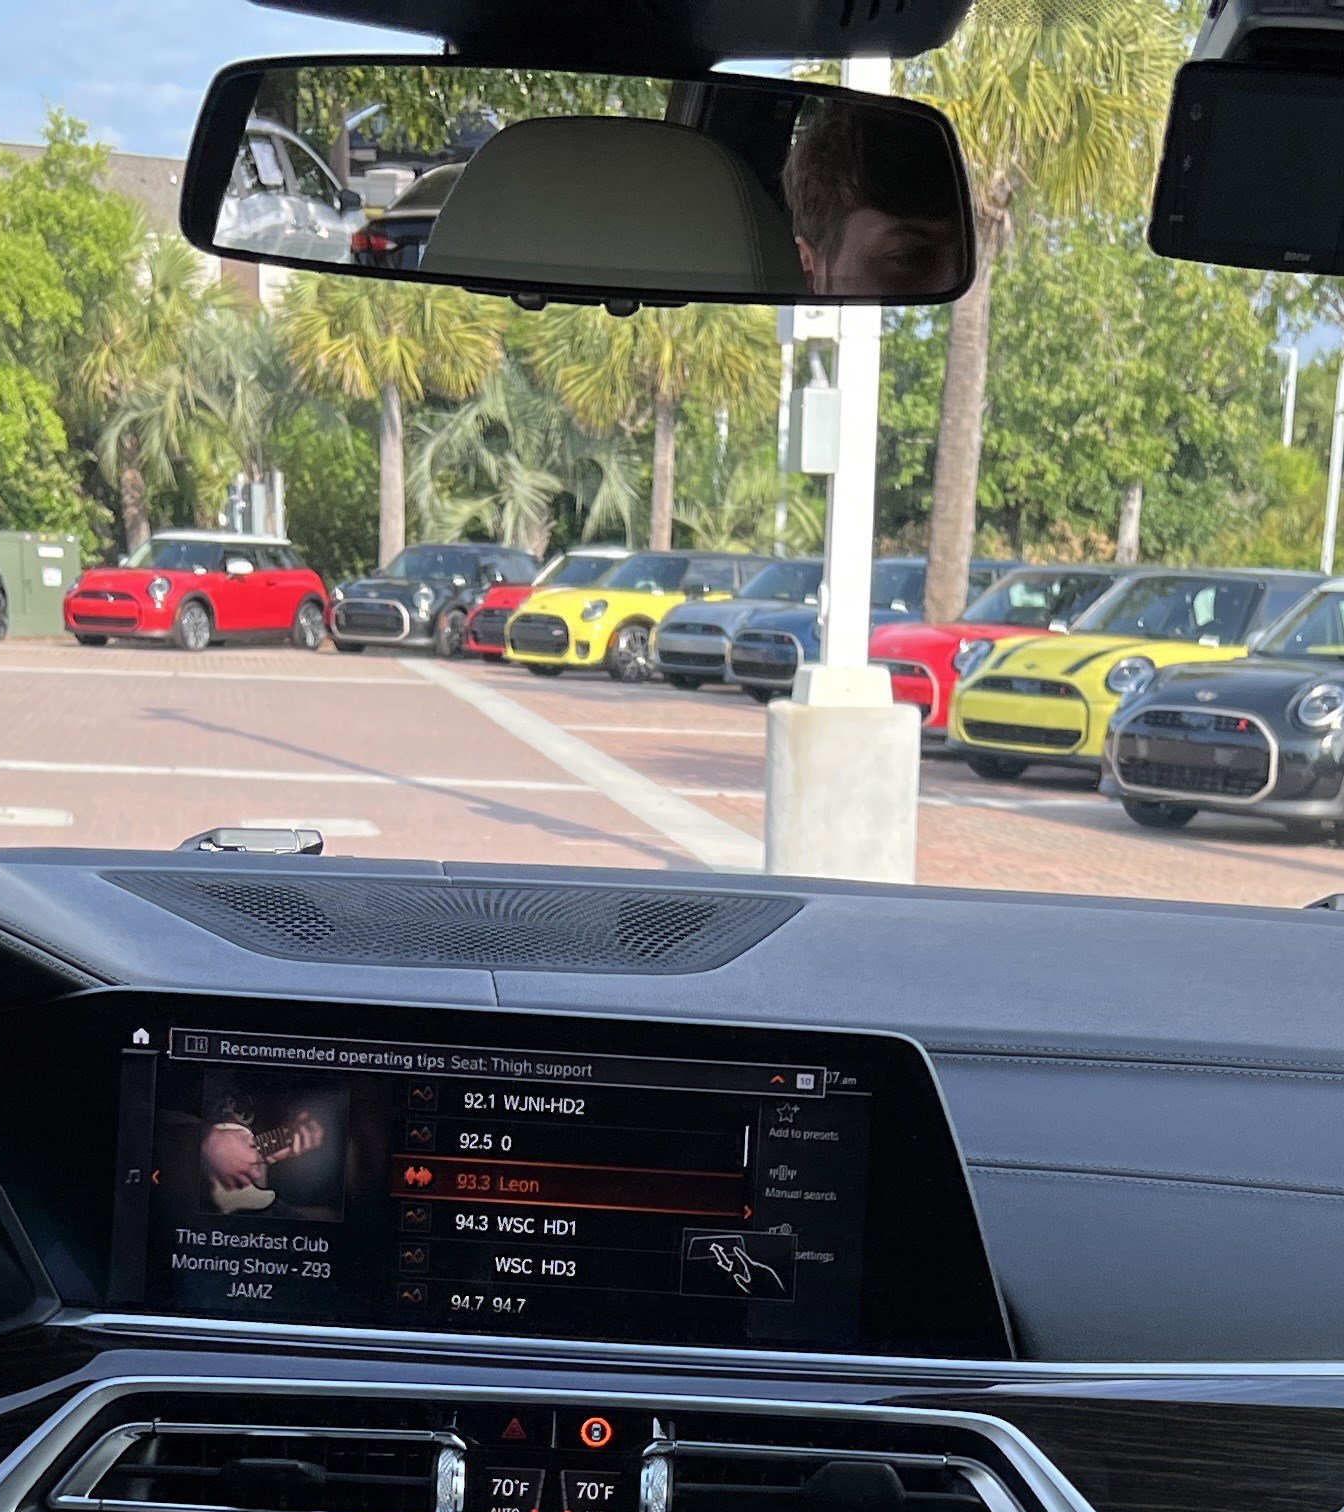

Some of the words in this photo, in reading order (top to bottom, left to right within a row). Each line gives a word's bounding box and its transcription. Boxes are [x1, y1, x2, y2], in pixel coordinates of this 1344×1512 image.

[219, 1039, 336, 1063] Recommended
[338, 1049, 413, 1069] operating
[416, 1053, 445, 1069] tips
[450, 1055, 488, 1072] Seat:
[491, 1057, 533, 1075] Thigh
[535, 1063, 594, 1079] support
[463, 1092, 496, 1109] 92.1
[503, 1094, 586, 1115] WJNI-HD2
[459, 1132, 493, 1150] 92.5
[768, 1127, 790, 1139] Add
[791, 1129, 802, 1139] to
[803, 1130, 840, 1141] presets
[457, 1174, 491, 1191] 93.3
[498, 1176, 540, 1193] Leon
[764, 1187, 802, 1199] Manual
[803, 1190, 837, 1201] search
[455, 1213, 489, 1231] 94.3
[496, 1215, 535, 1235] WSC
[543, 1218, 577, 1236] HD1
[175, 1228, 207, 1246] The
[211, 1230, 288, 1251] Breakfast
[292, 1235, 329, 1253] Club
[171, 1253, 240, 1276] Morning
[242, 1257, 289, 1275] Show
[300, 1260, 332, 1279] Z93
[494, 1256, 533, 1275] WSC
[541, 1259, 577, 1277] HD3
[795, 1251, 835, 1263] settings
[226, 1282, 274, 1300] JAMZ
[450, 1294, 485, 1311] 94.7
[491, 1296, 527, 1314] 94.7
[492, 1478, 530, 1497] 70°F
[576, 1481, 615, 1500] 70°F
